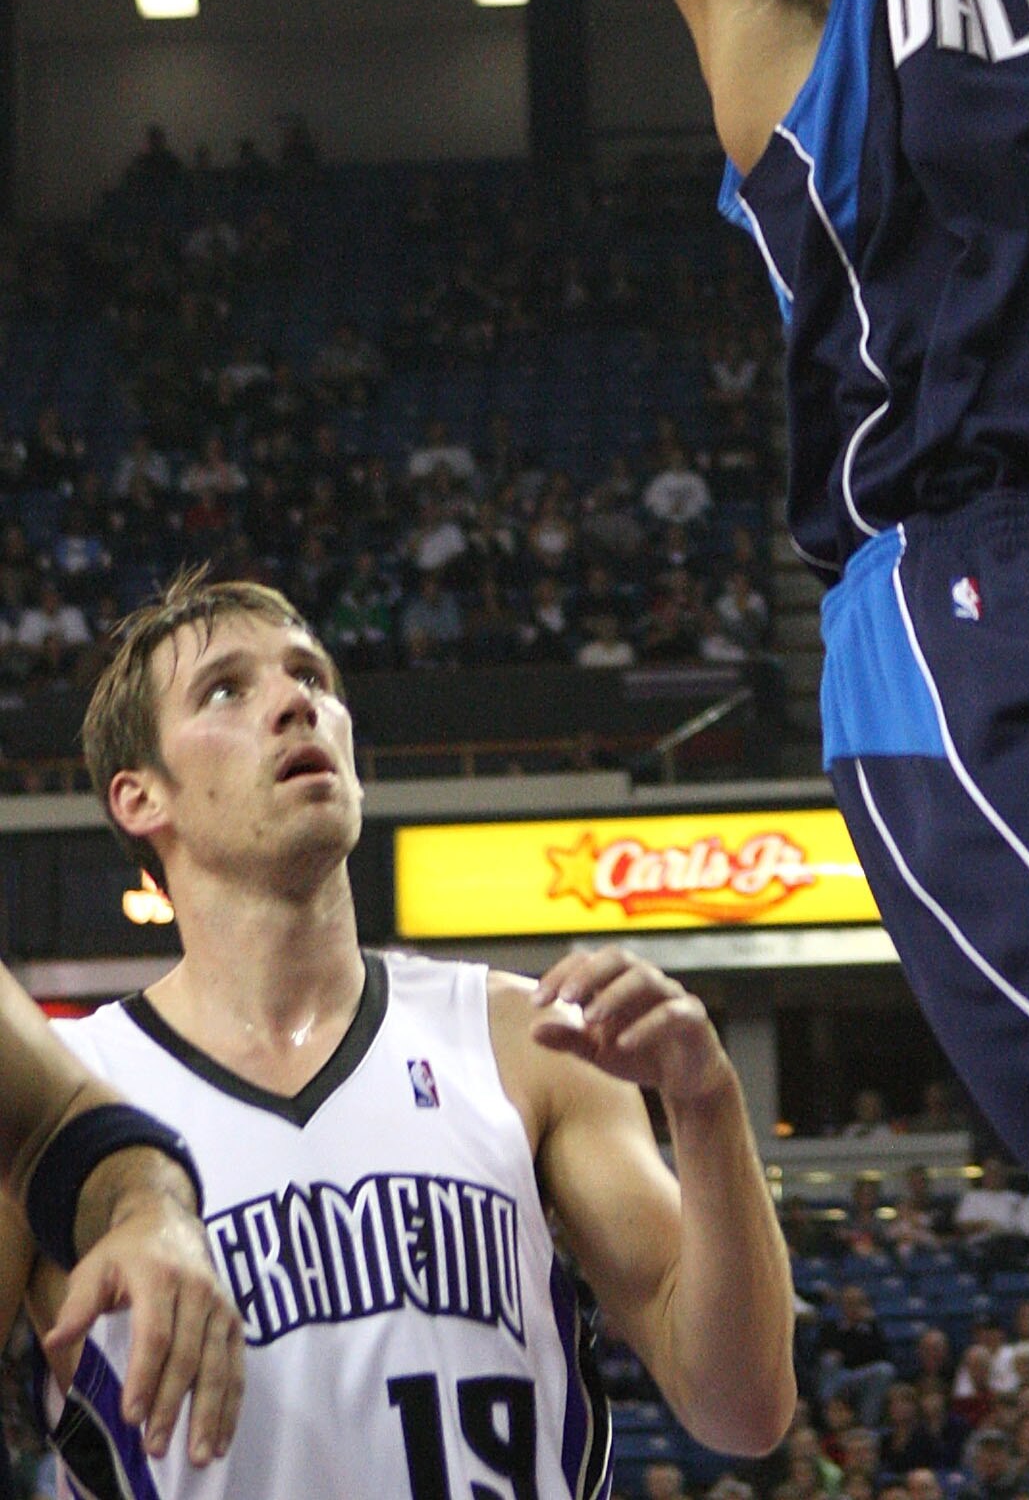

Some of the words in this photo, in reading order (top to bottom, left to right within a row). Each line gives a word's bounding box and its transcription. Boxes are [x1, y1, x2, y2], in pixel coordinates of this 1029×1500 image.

[594, 837, 733, 898] Carl's
[203, 1172, 526, 1347] CRAMENTO
[386, 1372, 539, 1500] 19
